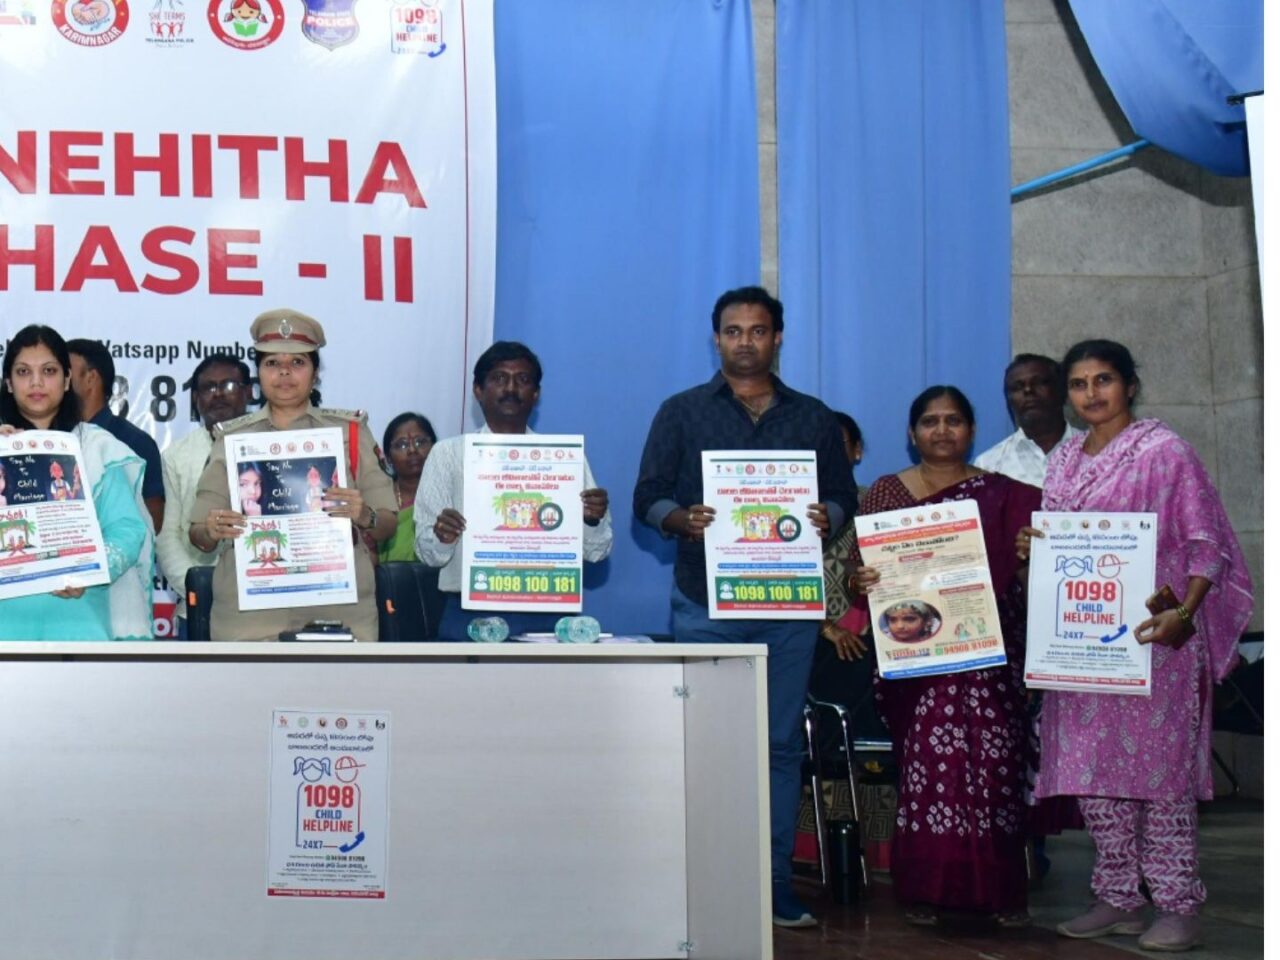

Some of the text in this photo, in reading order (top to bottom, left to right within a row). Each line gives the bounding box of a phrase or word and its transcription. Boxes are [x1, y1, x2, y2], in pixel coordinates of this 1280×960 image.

[306, 16, 353, 27] POLICE
[59, 24, 122, 46] KARIMNAGAR
[298, 263, 327, 278] -
[363, 234, 414, 304] II
[187, 339, 257, 361] Numbe
[17, 479, 38, 488] Child
[13, 492, 45, 501] Marriage
[272, 487, 293, 497] Child
[268, 502, 299, 512] Marriage
[488, 575, 576, 593] 1098 100 181
[734, 585, 818, 600] 1098 100 181
[1065, 581, 1117, 601] 1098
[1075, 602, 1103, 613] CHILD
[1063, 612, 1115, 625] HELPLINE
[1062, 631, 1084, 641] 24X7
[304, 784, 354, 808] 1098
[315, 809, 342, 820] CHILD
[303, 819, 353, 832] HELPLINE
[302, 840, 323, 849] 24X7
